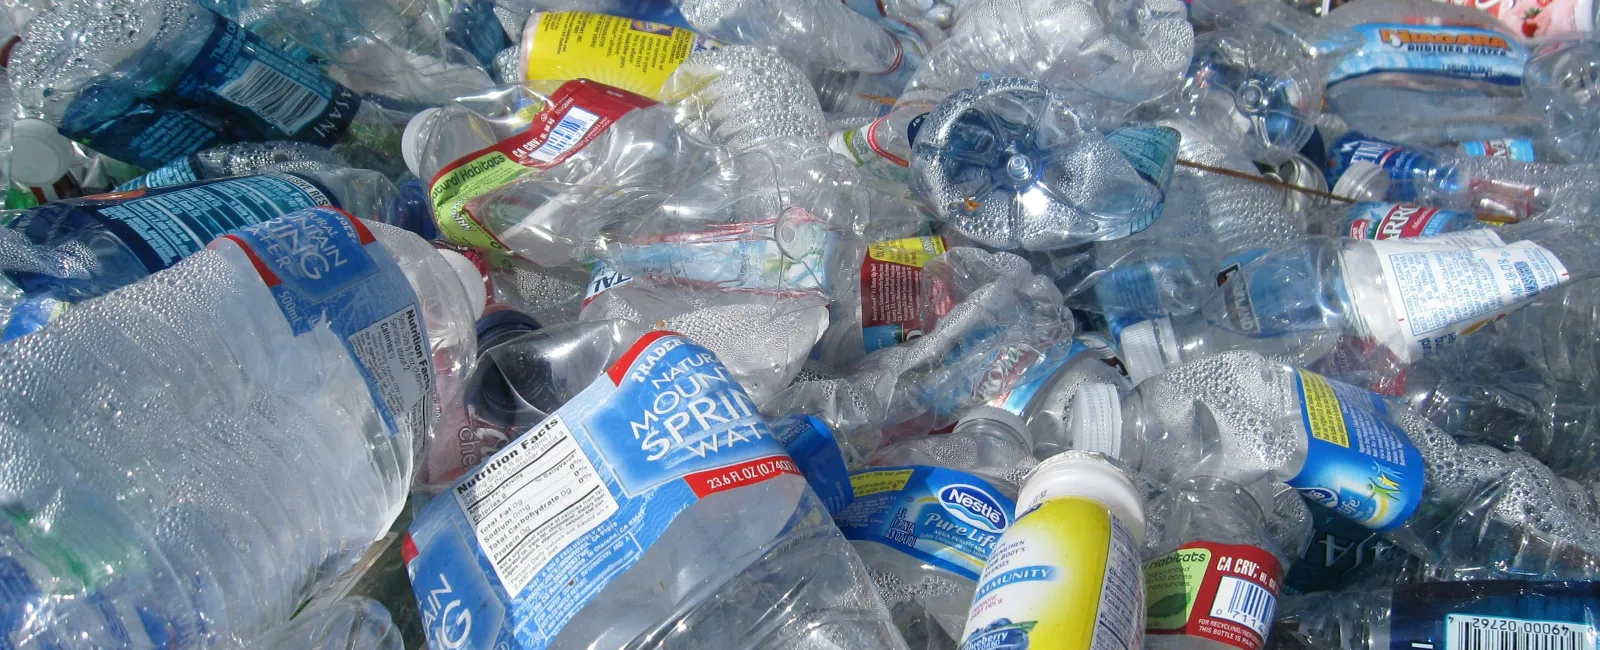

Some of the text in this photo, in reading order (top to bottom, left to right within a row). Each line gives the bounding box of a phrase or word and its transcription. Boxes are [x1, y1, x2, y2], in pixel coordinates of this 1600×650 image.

[1378, 28, 1512, 51] NIAGARA
[1467, 45, 1507, 57] WATER
[512, 136, 543, 159] CA CRV;
[461, 152, 506, 182] Habitats
[277, 290, 304, 325] 500mL
[380, 321, 393, 354] Calories
[389, 317, 402, 348] Servings
[396, 347, 409, 367] about
[406, 308, 432, 392] Nutrition Facts
[631, 337, 684, 384] TRADER
[685, 422, 763, 459] WAT
[456, 417, 559, 496] Nutrition Facts
[460, 433, 553, 502] Serving Size 8 fl oz (240mL)
[464, 431, 565, 508] Servings Per Container about 3
[569, 457, 583, 470] 0%
[573, 465, 588, 478] 0%
[577, 472, 592, 485] 0%
[706, 472, 732, 490] 23.6
[731, 469, 744, 482] FL
[743, 466, 759, 480] OZ
[468, 472, 525, 516] Amount Per Serving
[472, 493, 508, 523] Calories 0
[480, 498, 524, 536] Total Fat 0g
[483, 503, 532, 544] Sodium 0mg
[488, 486, 573, 552] Total Carbohydrate 0g
[536, 521, 554, 538] source
[554, 516, 561, 524] of
[561, 503, 583, 519] calories
[582, 494, 596, 507] from
[619, 523, 629, 533] CA
[923, 512, 969, 537] Pure
[493, 525, 531, 561] Protein 0g
[530, 507, 607, 566] Daily Values are based on
[590, 532, 602, 543] CA
[933, 529, 951, 540] AGUA
[951, 535, 988, 555] PURIFICADA
[512, 545, 560, 591] 2,000 calorie diet
[1000, 546, 1026, 562] BODY'S
[1149, 580, 1192, 590] resources.
[1167, 573, 1193, 581] acres
[1216, 556, 1233, 572] CA
[1233, 558, 1260, 579] CRV;
[1258, 571, 1268, 586] HI,
[1104, 594, 1120, 612] Total
[1215, 608, 1223, 616] 0
[1100, 612, 1124, 637] Protein
[1198, 618, 1210, 627] FOR
[1199, 625, 1212, 634] THIS
[1212, 628, 1235, 640] BOTTLE
[1448, 616, 1570, 637] 49000 02762 4
